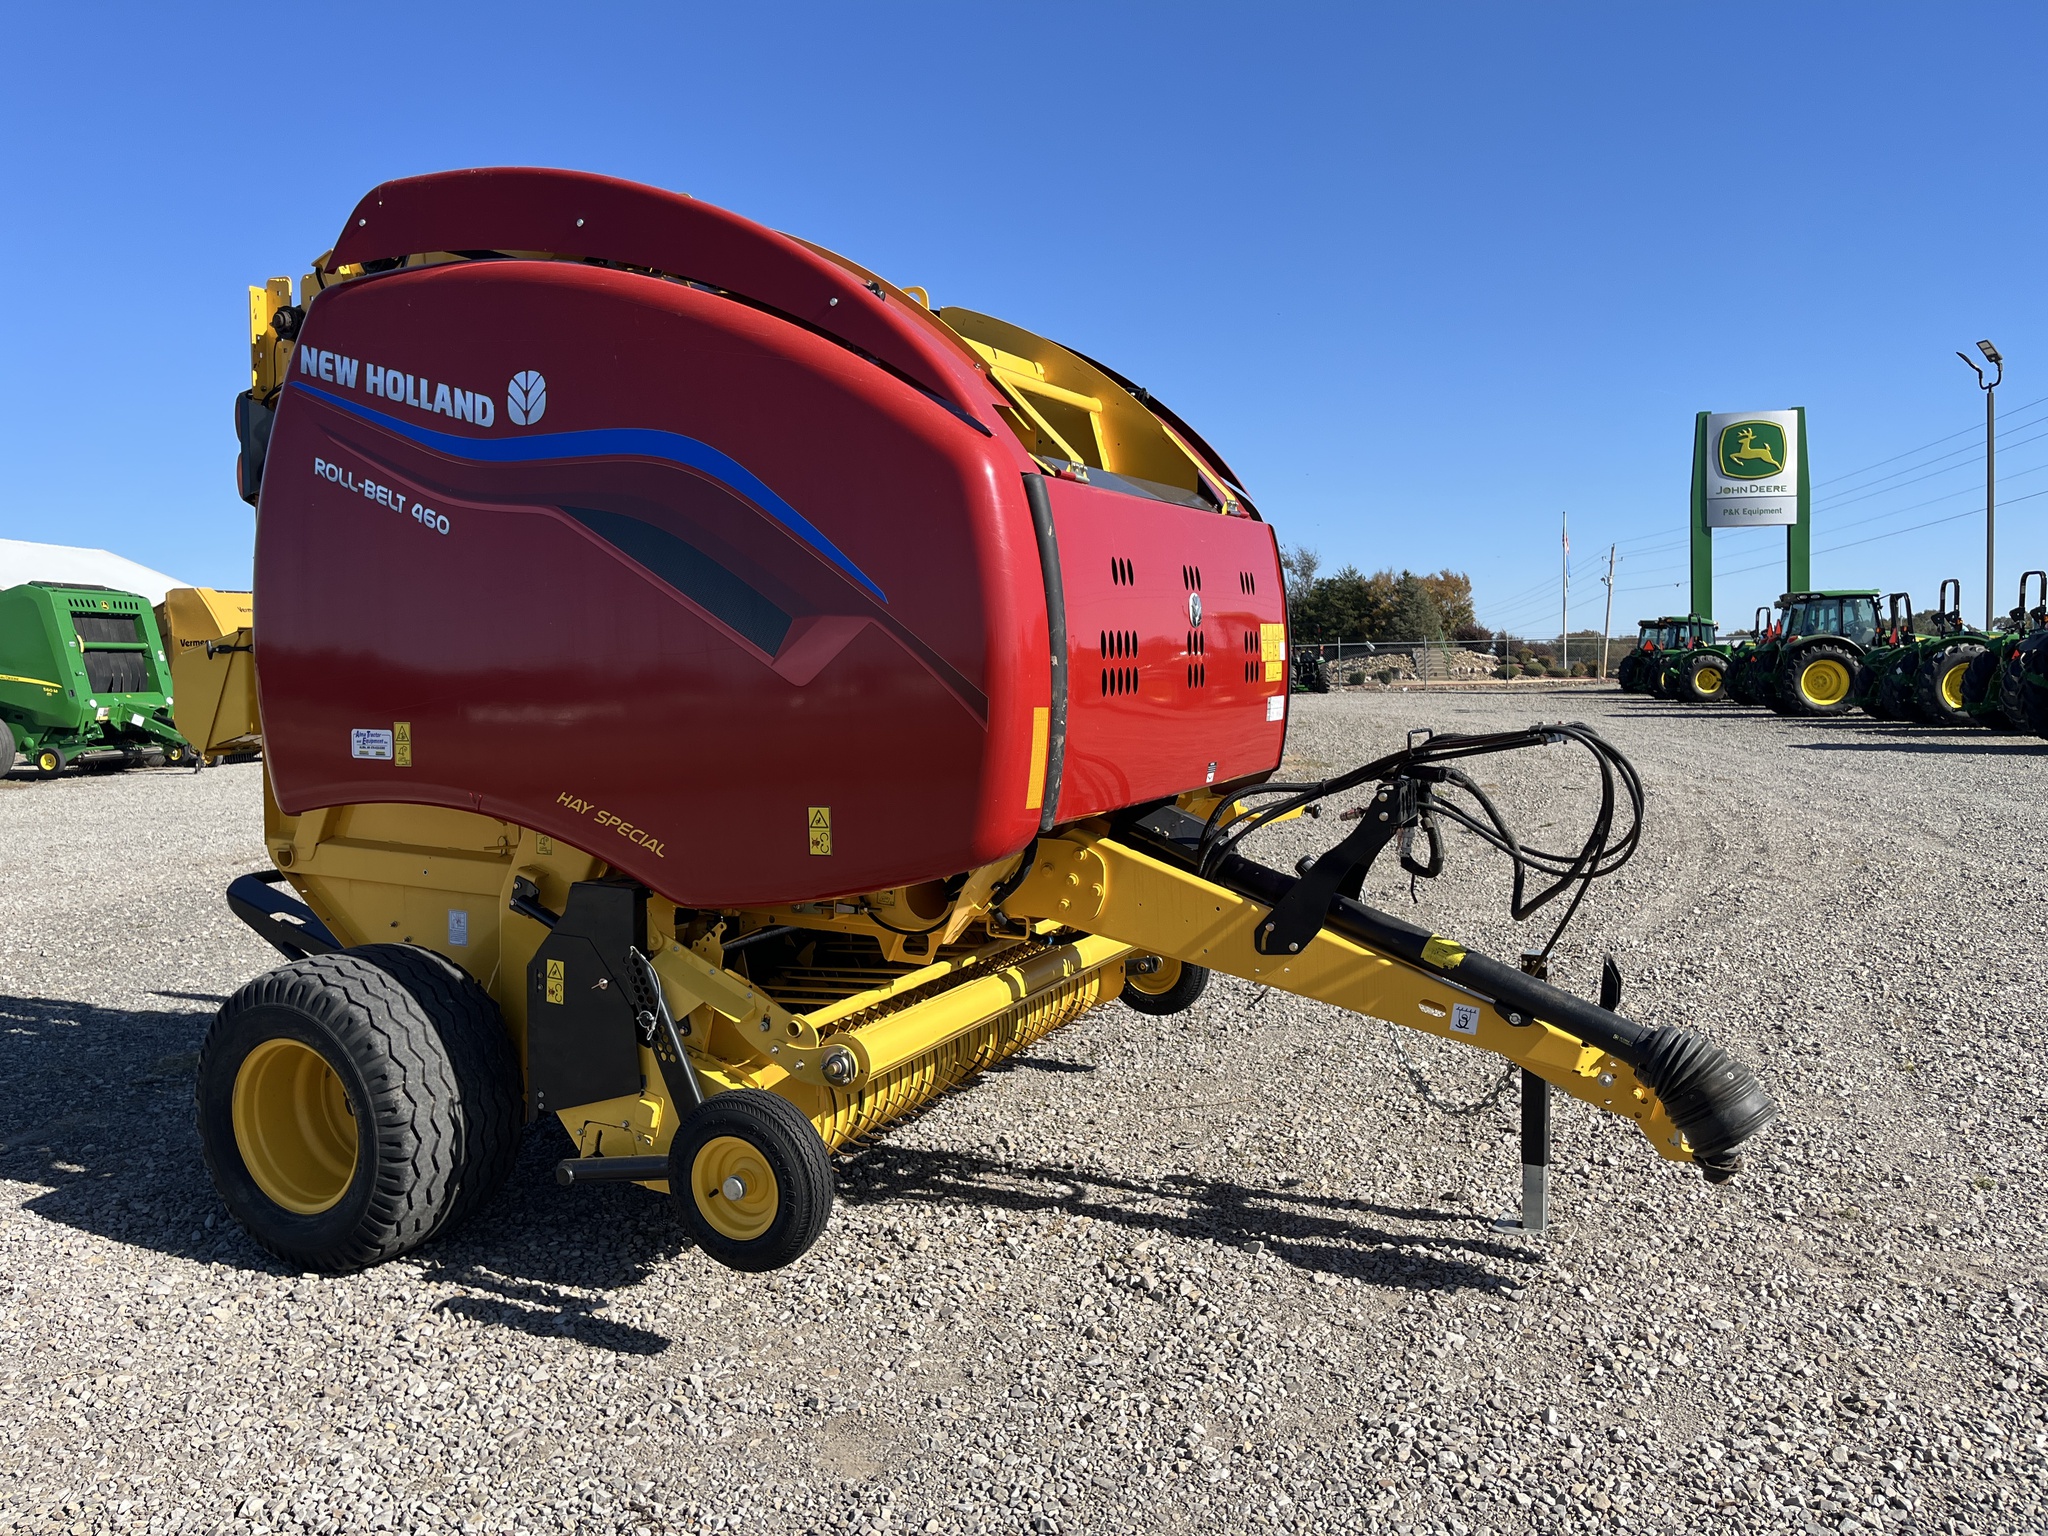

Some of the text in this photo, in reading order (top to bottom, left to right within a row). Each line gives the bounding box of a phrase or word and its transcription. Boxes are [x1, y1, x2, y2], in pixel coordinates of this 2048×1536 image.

[300, 344, 495, 428] NEW HOLLAND
[313, 457, 450, 536] ROLL-BELT 460
[1716, 484, 1788, 495] JOHN DEERE
[1723, 507, 1783, 516] P&K Equipment
[556, 791, 666, 859] HAY SPECIAL
